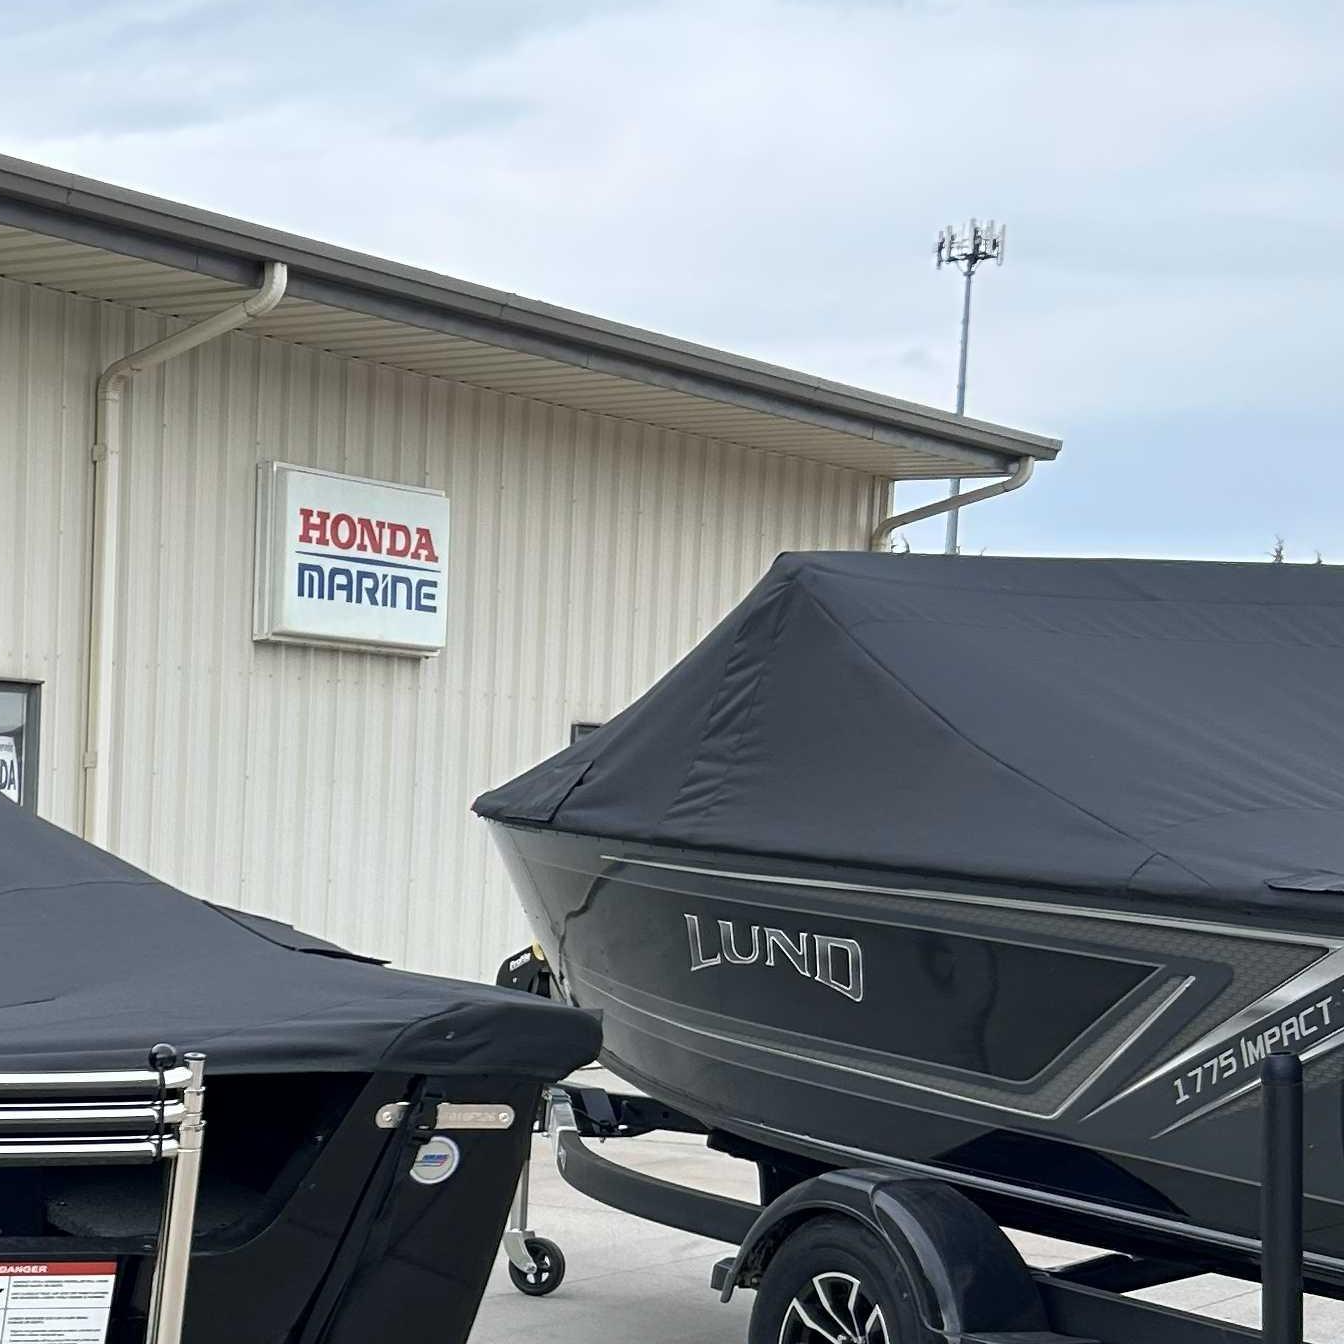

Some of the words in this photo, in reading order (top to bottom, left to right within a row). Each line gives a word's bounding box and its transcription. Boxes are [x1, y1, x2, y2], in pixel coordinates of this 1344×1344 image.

[298, 507, 439, 563] HONDA
[296, 562, 438, 614] MARINE
[683, 912, 864, 1003] LUND
[1172, 1047, 1238, 1105] 1775
[1239, 995, 1333, 1069] IMPACT
